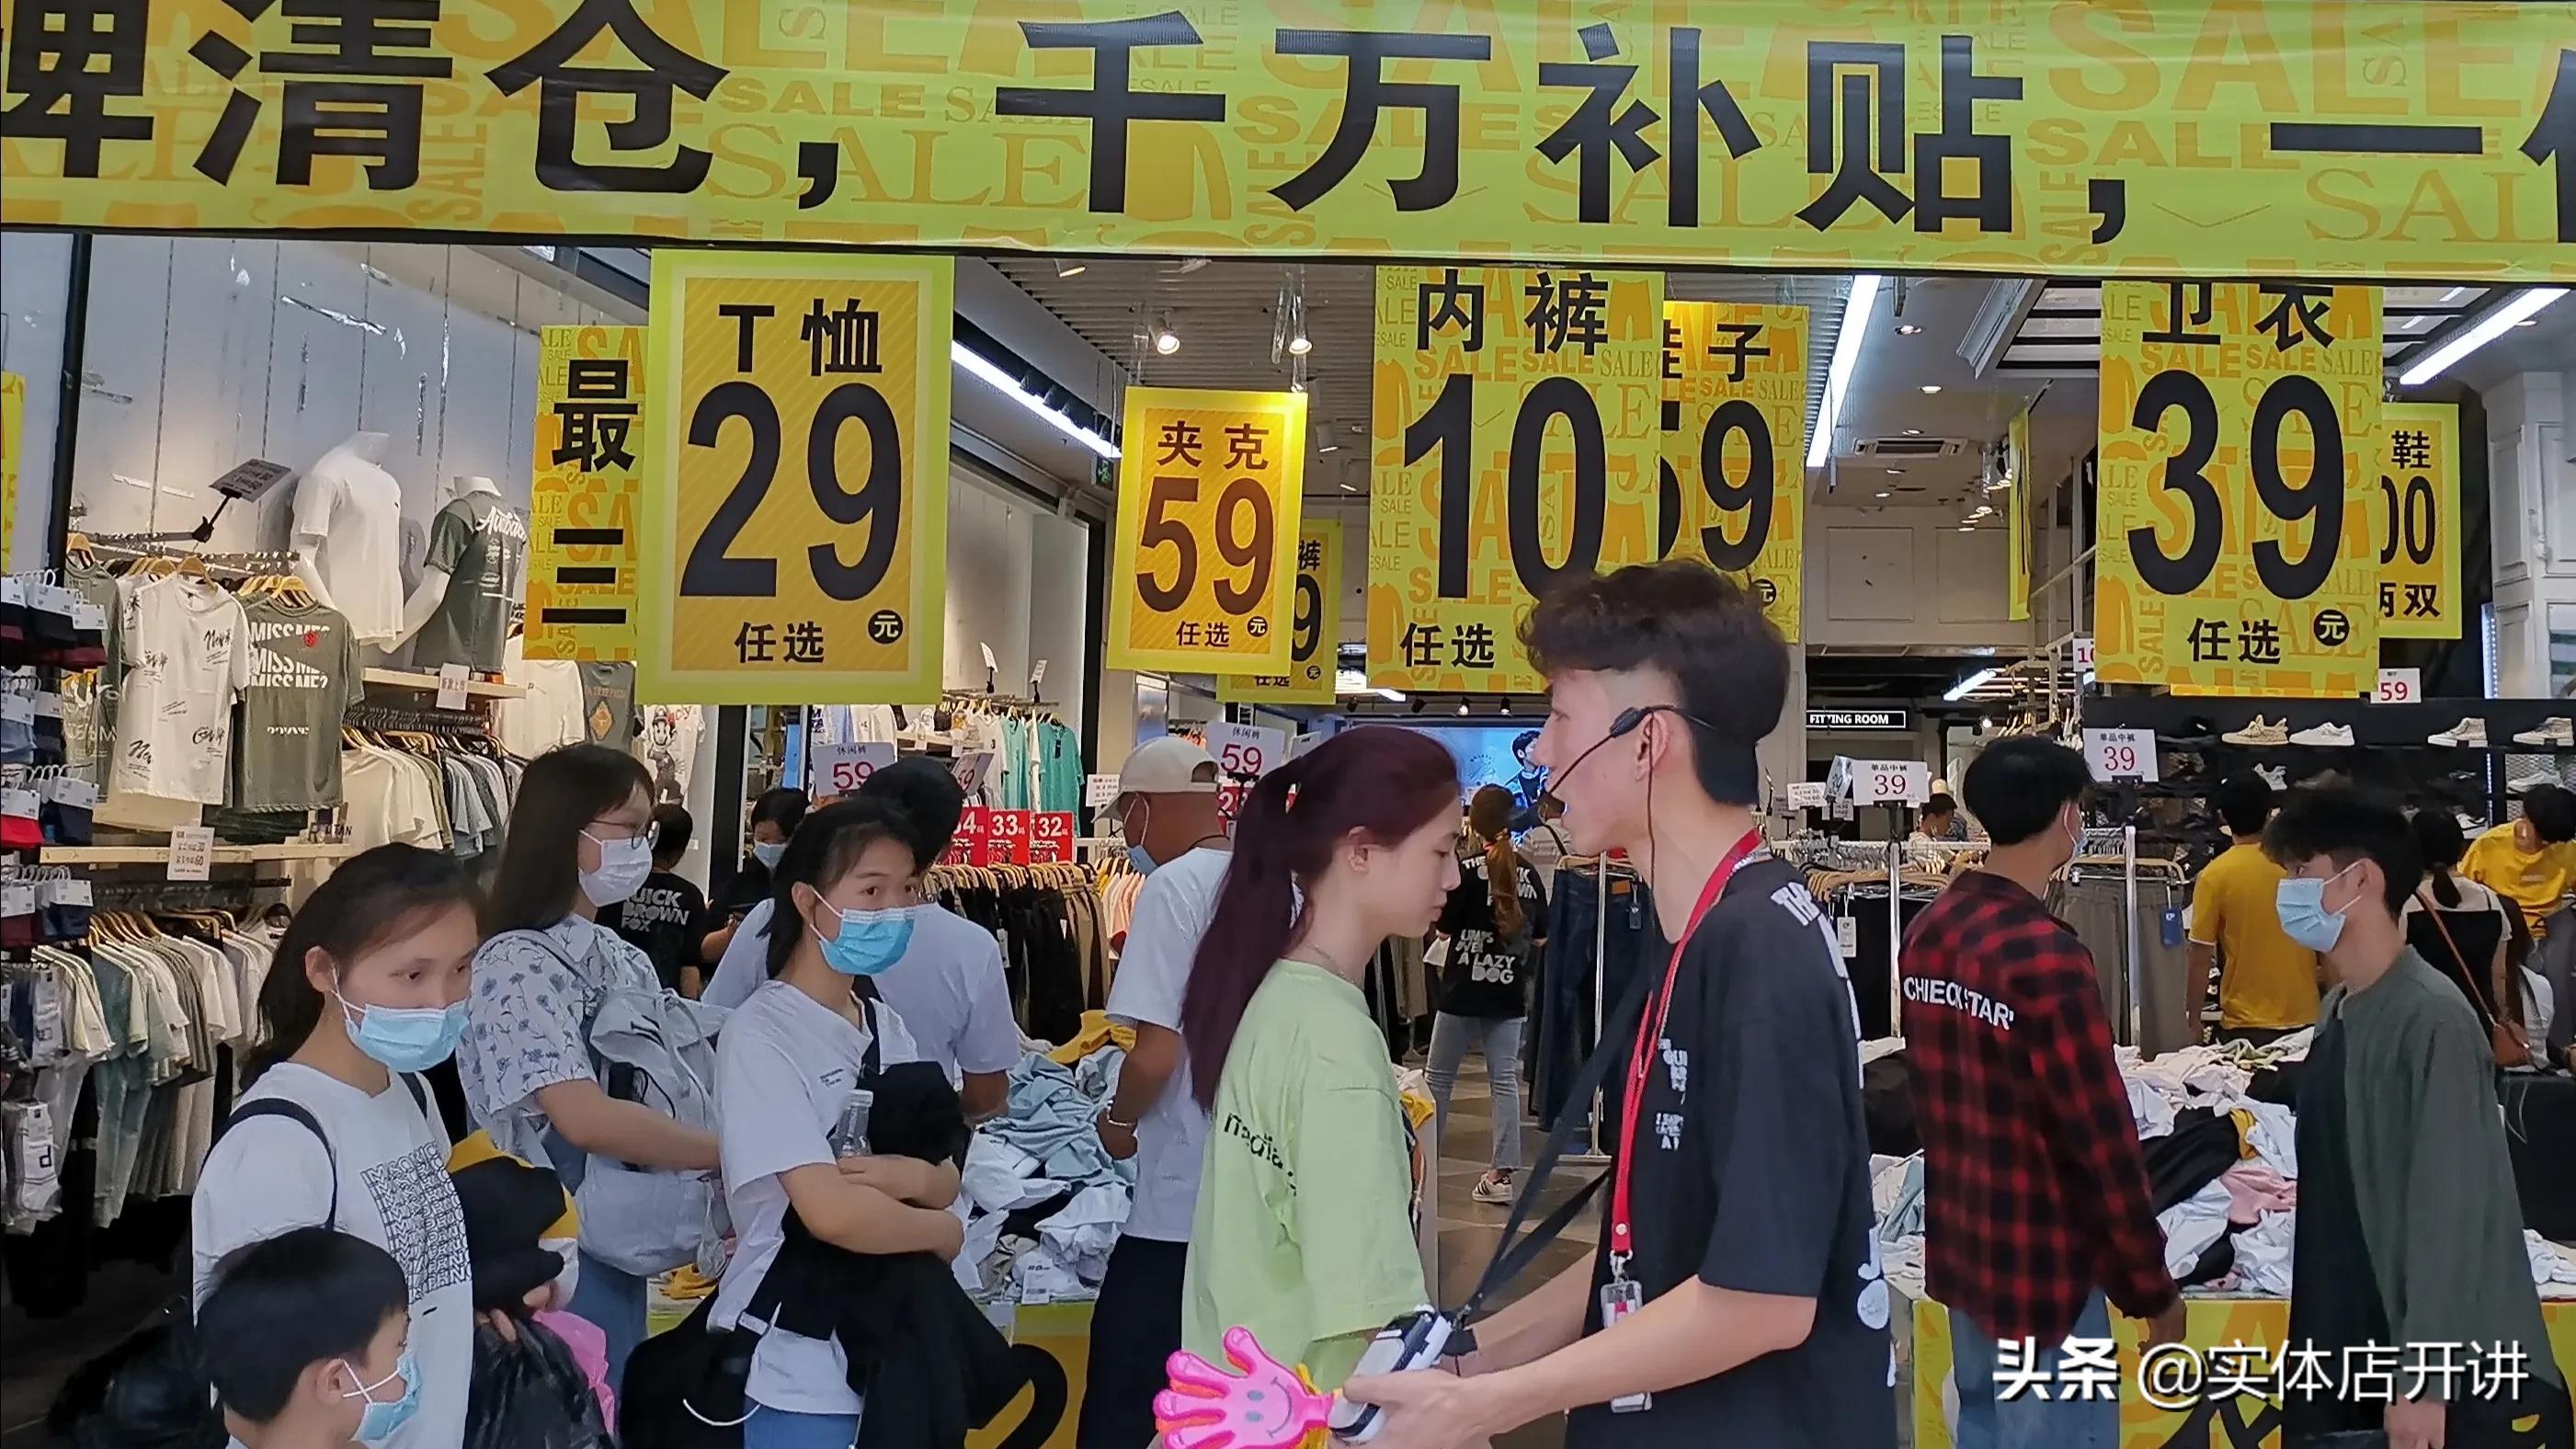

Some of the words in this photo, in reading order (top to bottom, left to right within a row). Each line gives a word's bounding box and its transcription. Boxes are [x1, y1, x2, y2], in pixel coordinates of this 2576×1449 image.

[2048, 0, 2521, 117] SALE
[717, 77, 926, 119] SALE
[2025, 118, 2299, 169] SALE
[706, 123, 1088, 210] SALE
[2306, 167, 2558, 242] SAL
[1417, 268, 1609, 355] 内裤
[2142, 282, 2335, 353] 卫衣
[719, 298, 883, 377] T恤
[1157, 420, 1270, 471] 夹克
[2392, 430, 2432, 470] 鞋
[679, 381, 902, 600] 29
[1404, 374, 1607, 603] 10
[2127, 370, 2345, 599] 39
[1136, 475, 1275, 616] 59
[735, 622, 826, 665] 任选
[871, 611, 903, 642] 元
[1176, 621, 1230, 648] 任选
[1248, 617, 1268, 636] 元
[1399, 622, 1496, 668] 任选
[2187, 618, 2282, 665] 任选
[2316, 612, 2348, 644] 元
[2380, 682, 2409, 702] 59
[1854, 713, 1889, 724] ROOM
[1220, 743, 1263, 773] 59
[2103, 746, 2136, 771] 39
[1875, 774, 1907, 796] 39
[1471, 964, 1514, 985] DOG
[1473, 953, 1516, 970] LAZY
